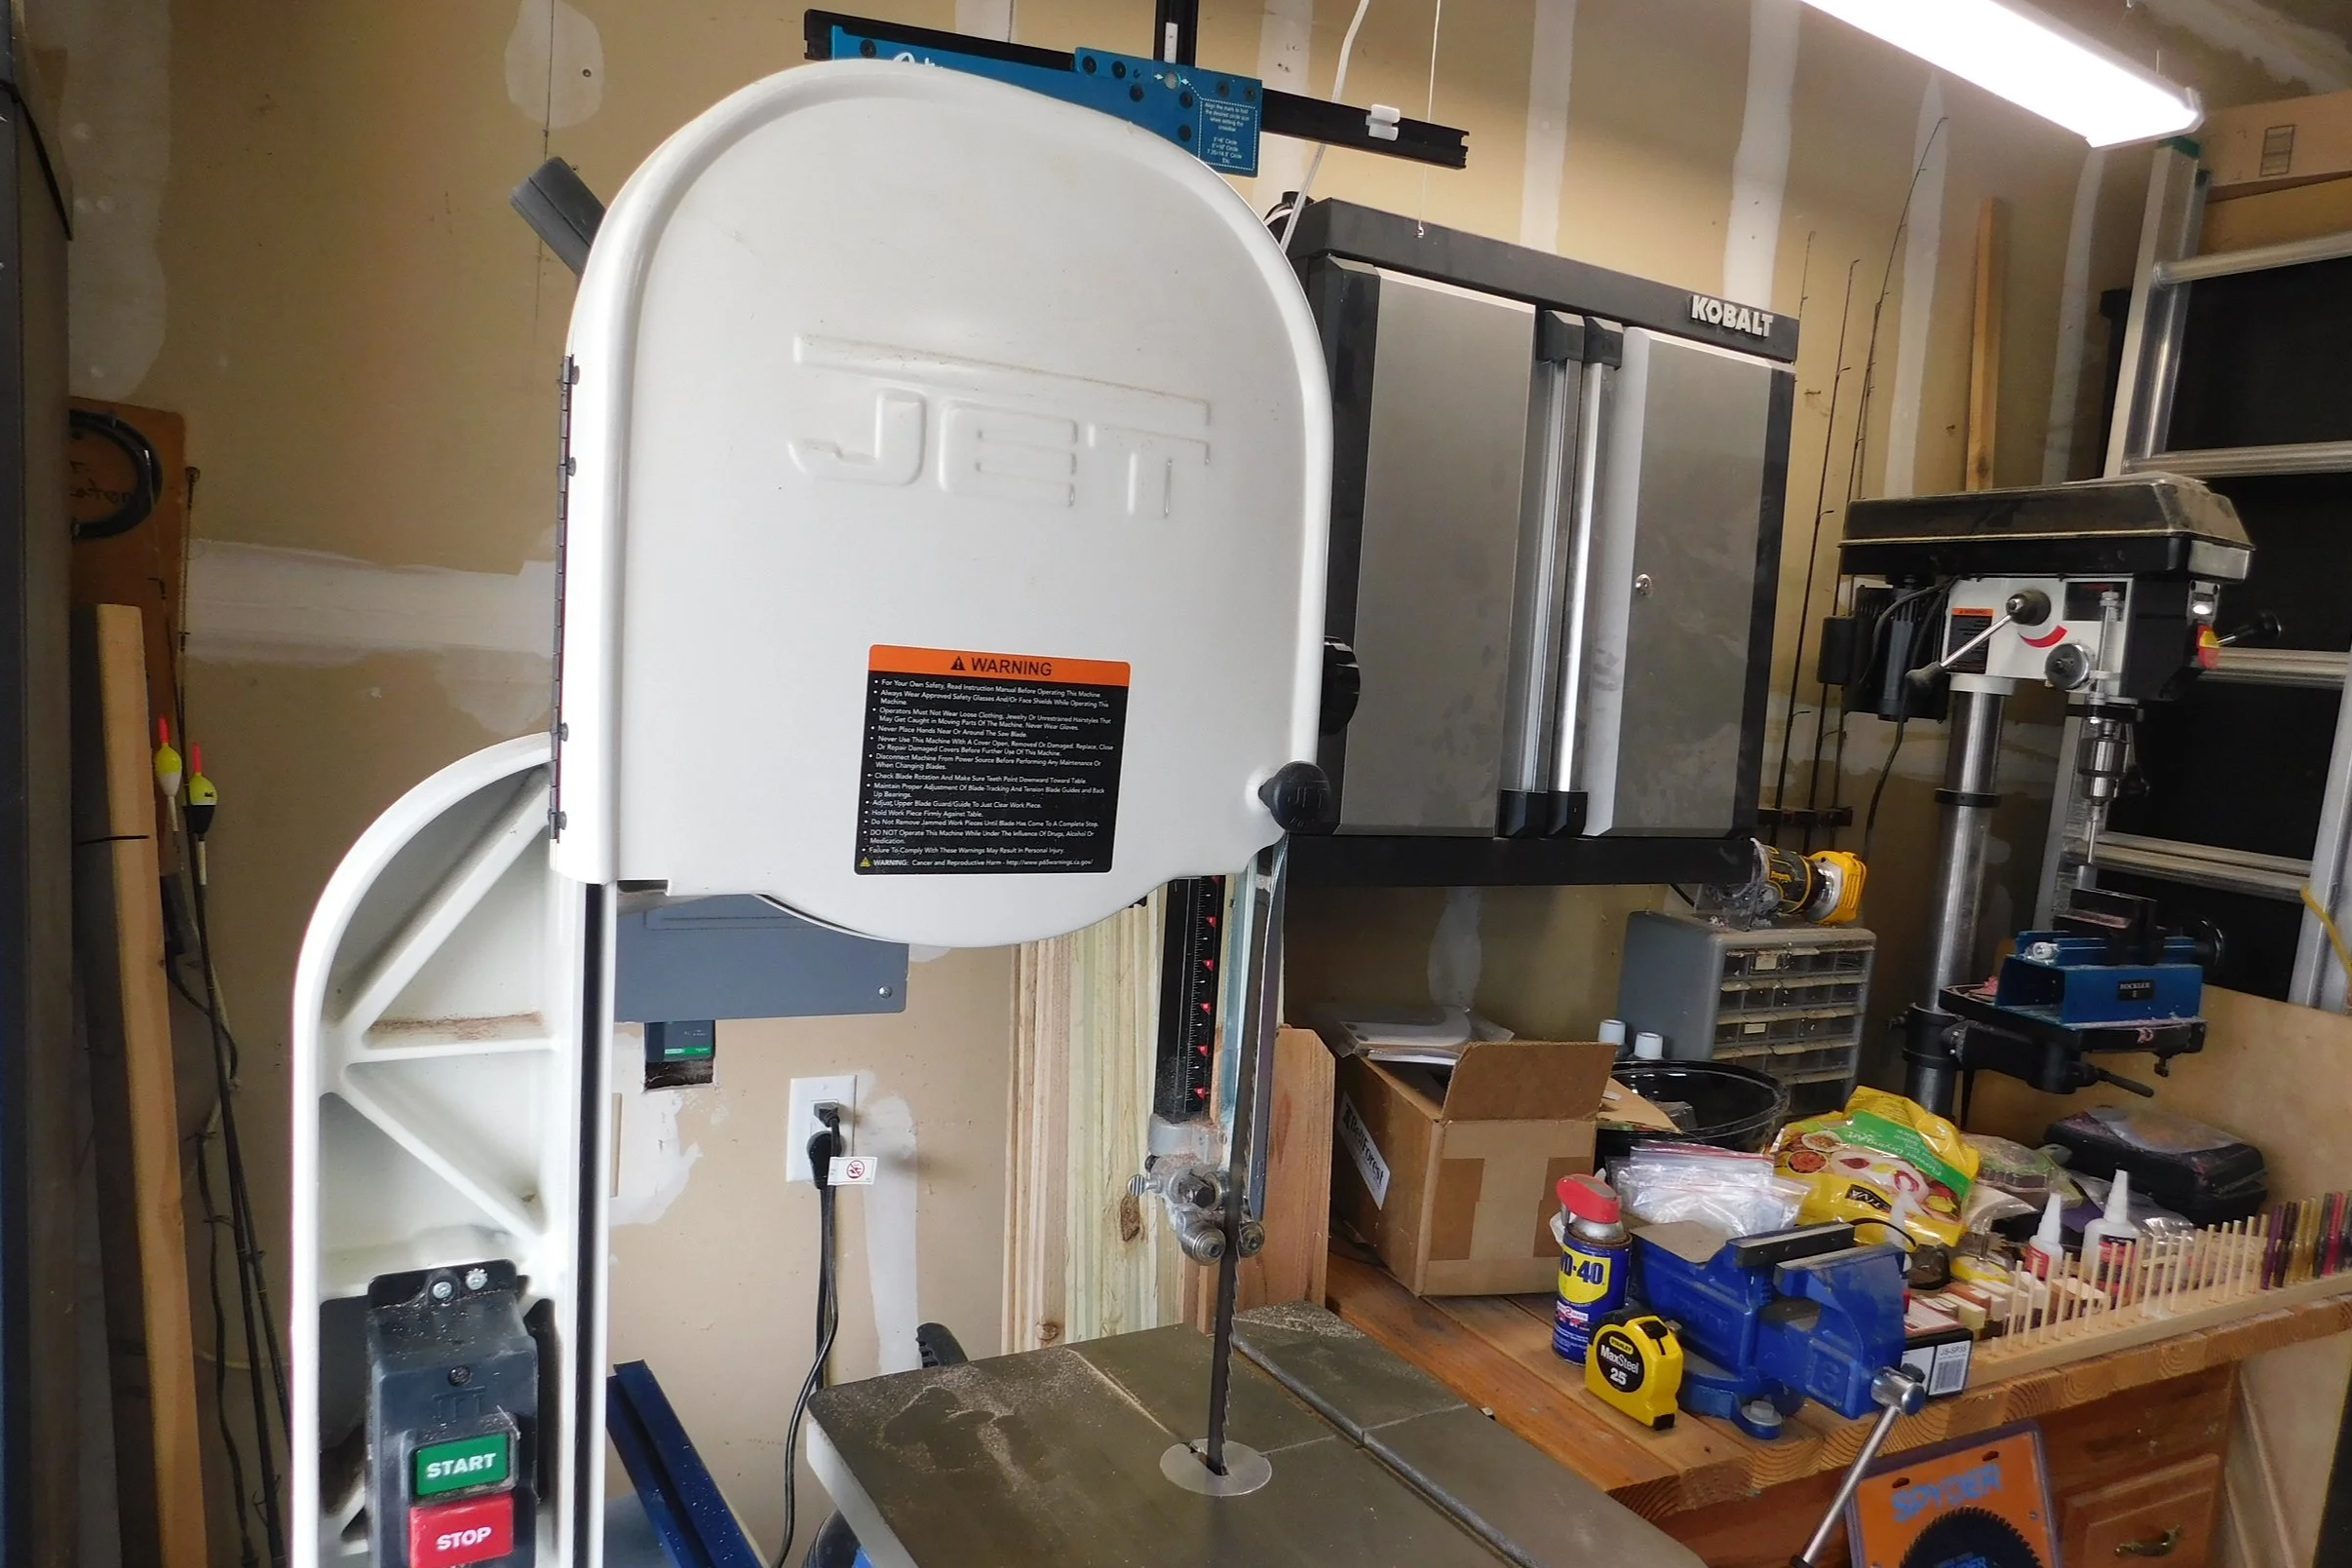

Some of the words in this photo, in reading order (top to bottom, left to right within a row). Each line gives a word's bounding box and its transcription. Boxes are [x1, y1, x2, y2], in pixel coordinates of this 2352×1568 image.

[1692, 295, 1774, 337] KOBALT
[789, 389, 1211, 519] JET
[971, 657, 1053, 676] WARNING
[1037, 688, 1065, 697] Operating
[1350, 1115, 1384, 1186] BellForest
[1611, 1338, 1632, 1352] STANLEY
[1600, 1345, 1639, 1374] MaxSteel
[1610, 1367, 1627, 1385] 25
[426, 1453, 496, 1479] START
[1891, 1463, 2003, 1523] SPYDER
[437, 1526, 491, 1551] STOP
